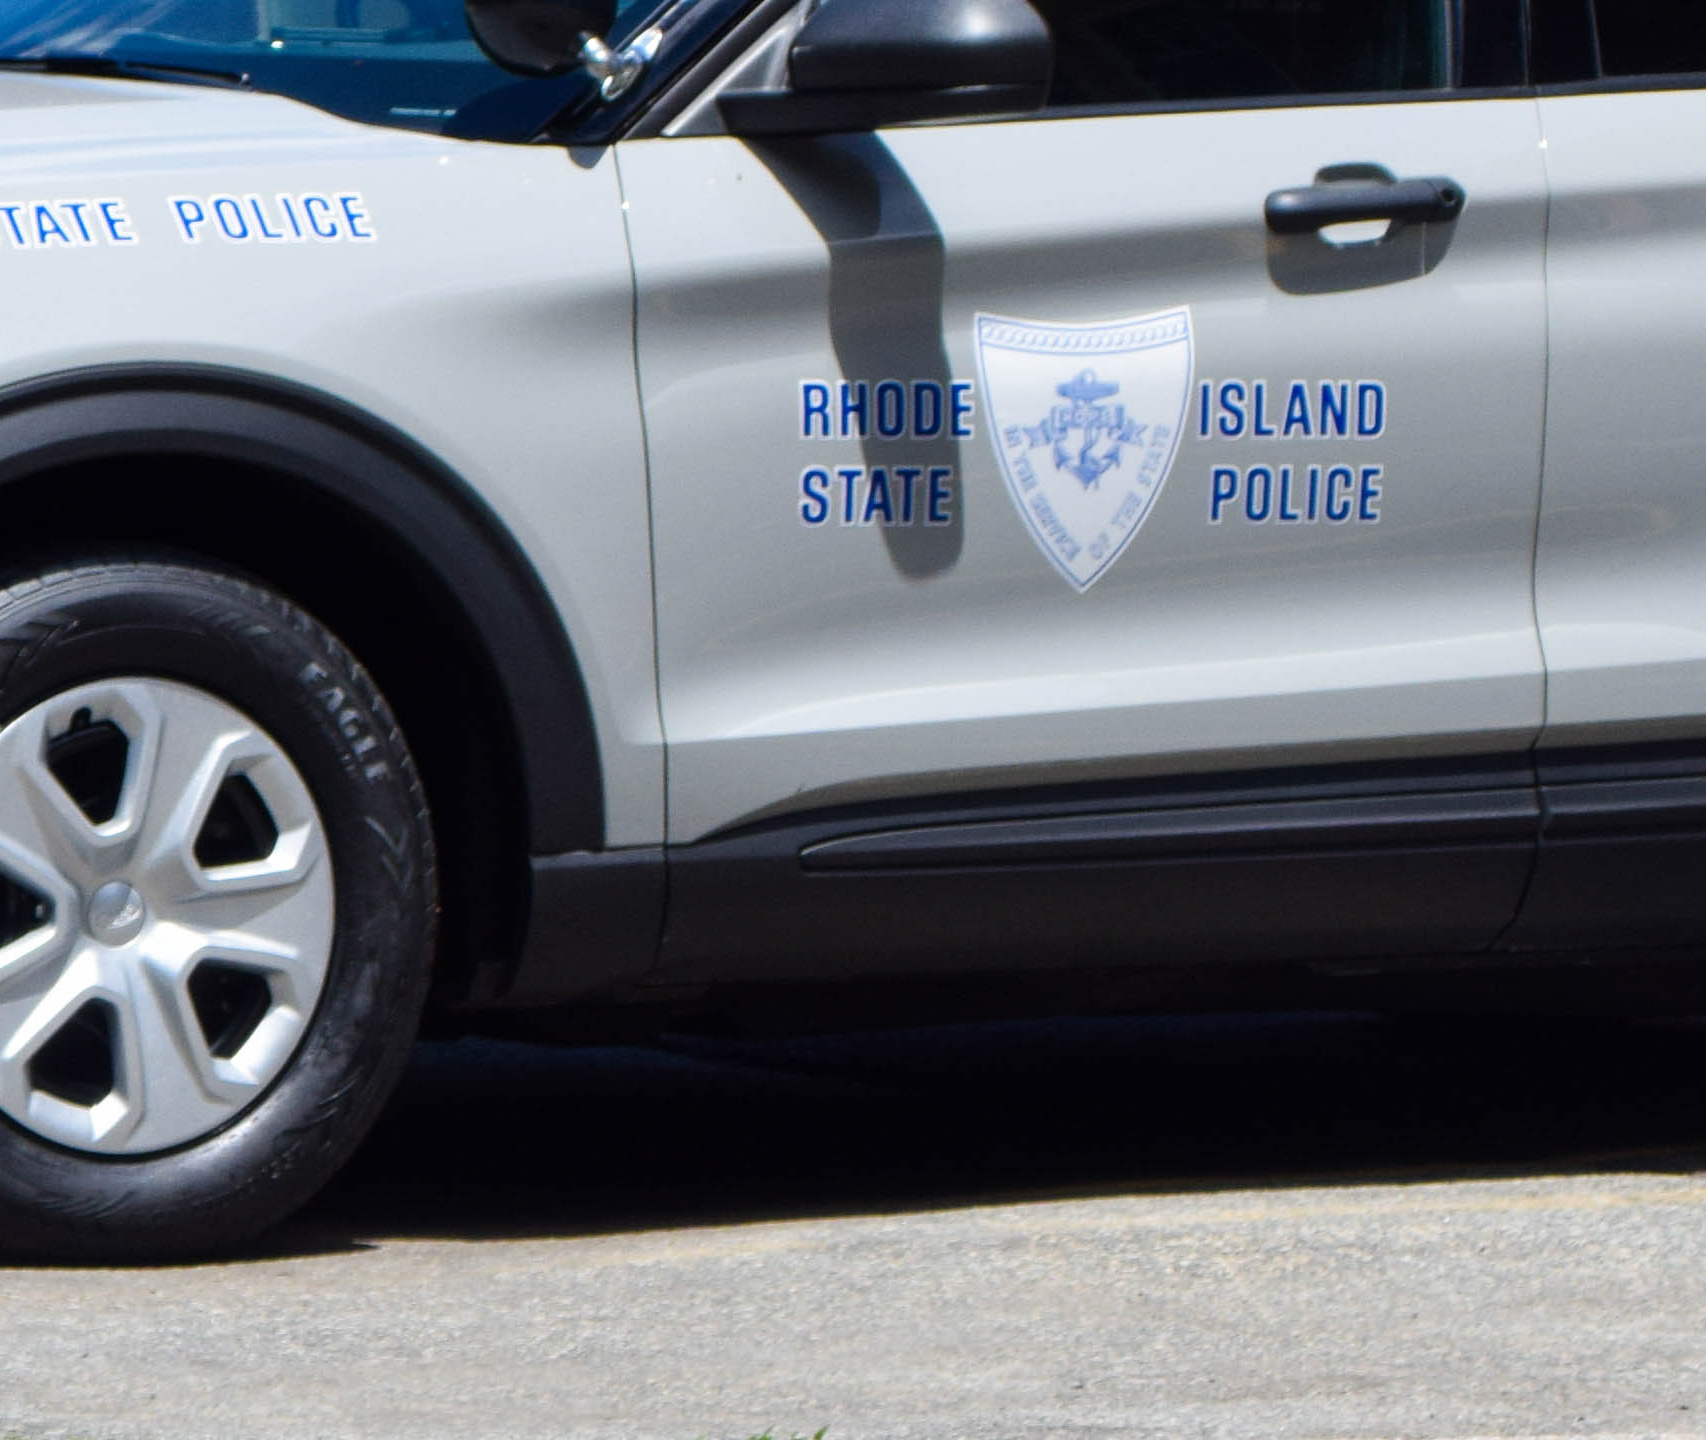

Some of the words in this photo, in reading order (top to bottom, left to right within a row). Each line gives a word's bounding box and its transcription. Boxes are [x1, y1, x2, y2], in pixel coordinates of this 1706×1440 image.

[173, 195, 373, 241] POLICE
[801, 382, 972, 437] RHODE
[1199, 381, 1386, 437] ISLAND
[801, 468, 952, 524] STATE
[1209, 467, 1383, 522] POLICE
[299, 660, 391, 783] EAGLE
